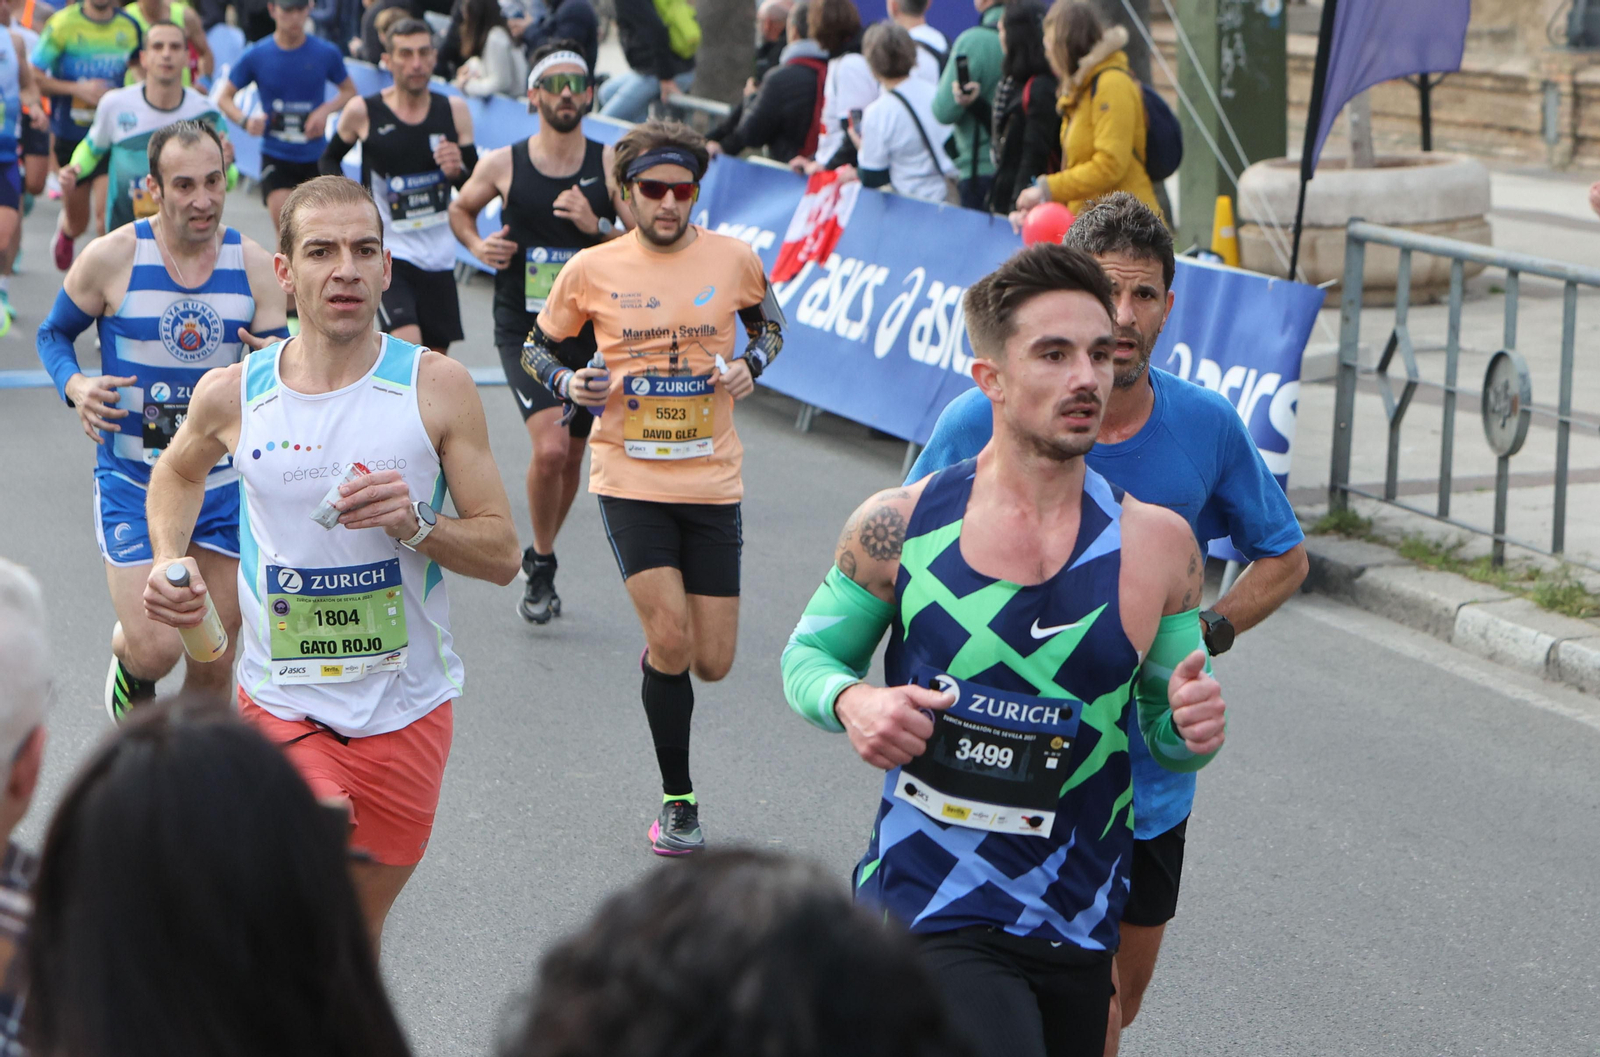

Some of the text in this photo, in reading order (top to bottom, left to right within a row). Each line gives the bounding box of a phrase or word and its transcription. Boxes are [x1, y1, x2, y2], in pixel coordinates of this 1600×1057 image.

[796, 252, 890, 341] asics
[162, 302, 220, 342] PENYA RUNNERS
[908, 280, 974, 378] asic
[622, 328, 670, 338] Maratón
[678, 324, 716, 336] Sevilla
[170, 345, 213, 360] ESPANYOL
[655, 380, 705, 393] ZURICH
[656, 407, 686, 420] 5523
[642, 428, 698, 440] DAVID GLEZ
[282, 466, 328, 485] pérez
[331, 462, 342, 477] &
[310, 568, 386, 590] ZURICH
[314, 609, 360, 627] 1804
[300, 638, 382, 654] GATO ROJO
[288, 666, 306, 674] asics
[968, 694, 1060, 726] ZURICH
[1001, 730, 1023, 740] SEVILLA
[955, 738, 1014, 770] 3499
